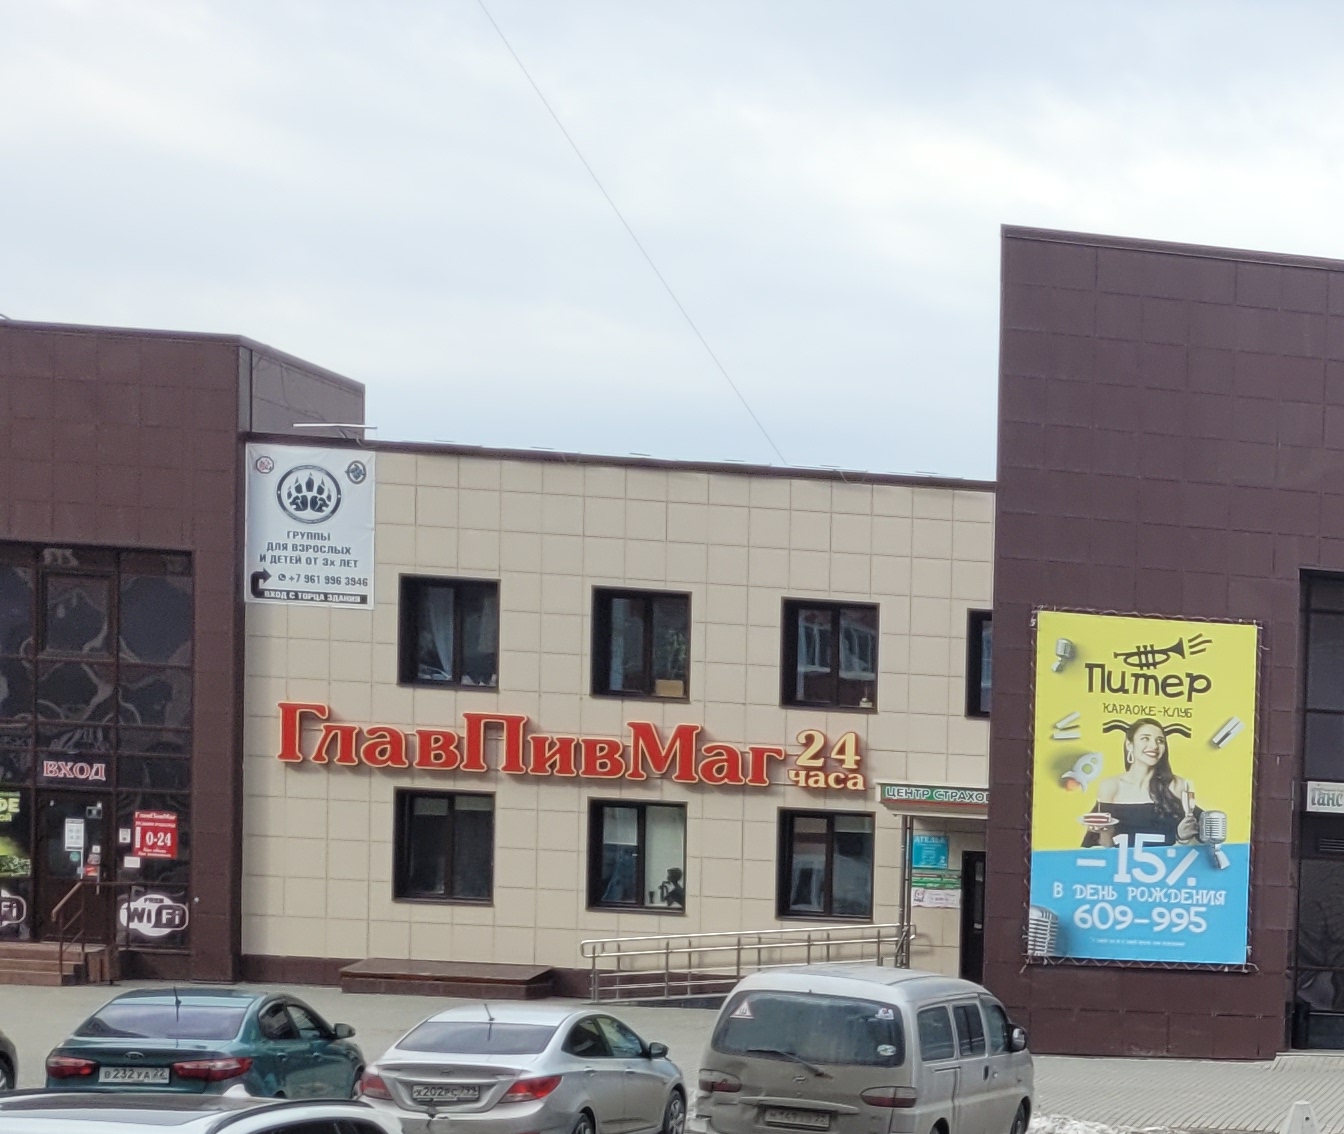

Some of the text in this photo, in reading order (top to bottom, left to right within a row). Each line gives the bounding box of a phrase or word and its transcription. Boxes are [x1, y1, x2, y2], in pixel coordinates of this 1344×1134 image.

[286, 530, 331, 541] ГРУППЫ
[266, 541, 352, 555] ДЛЯ ВЗРОСЛЫХ
[259, 554, 267, 563] И
[269, 554, 302, 565] ДЕТЕЙ
[305, 556, 319, 566] ОТ
[339, 559, 360, 568] ЛЕТ
[288, 573, 369, 587] +7 961 996 3946
[264, 590, 361, 603] ВХОД С ТОРЦА ЗДАНИЯ
[1084, 662, 1213, 703] Питер
[1102, 702, 1194, 719] КАРАОКЕ-КЛУБ
[276, 701, 786, 787] ГлавПивМаг
[794, 728, 862, 770] 24
[43, 760, 107, 782] ВХОД
[787, 769, 867, 791] часа
[886, 786, 931, 800] ЦЕНТР
[1311, 786, 1344, 808] Ганс
[145, 831, 172, 847] 0-24
[1052, 881, 1227, 907] В ДЕНЬ РОЖДЕНИЯ
[1073, 901, 1208, 934] 609-995
